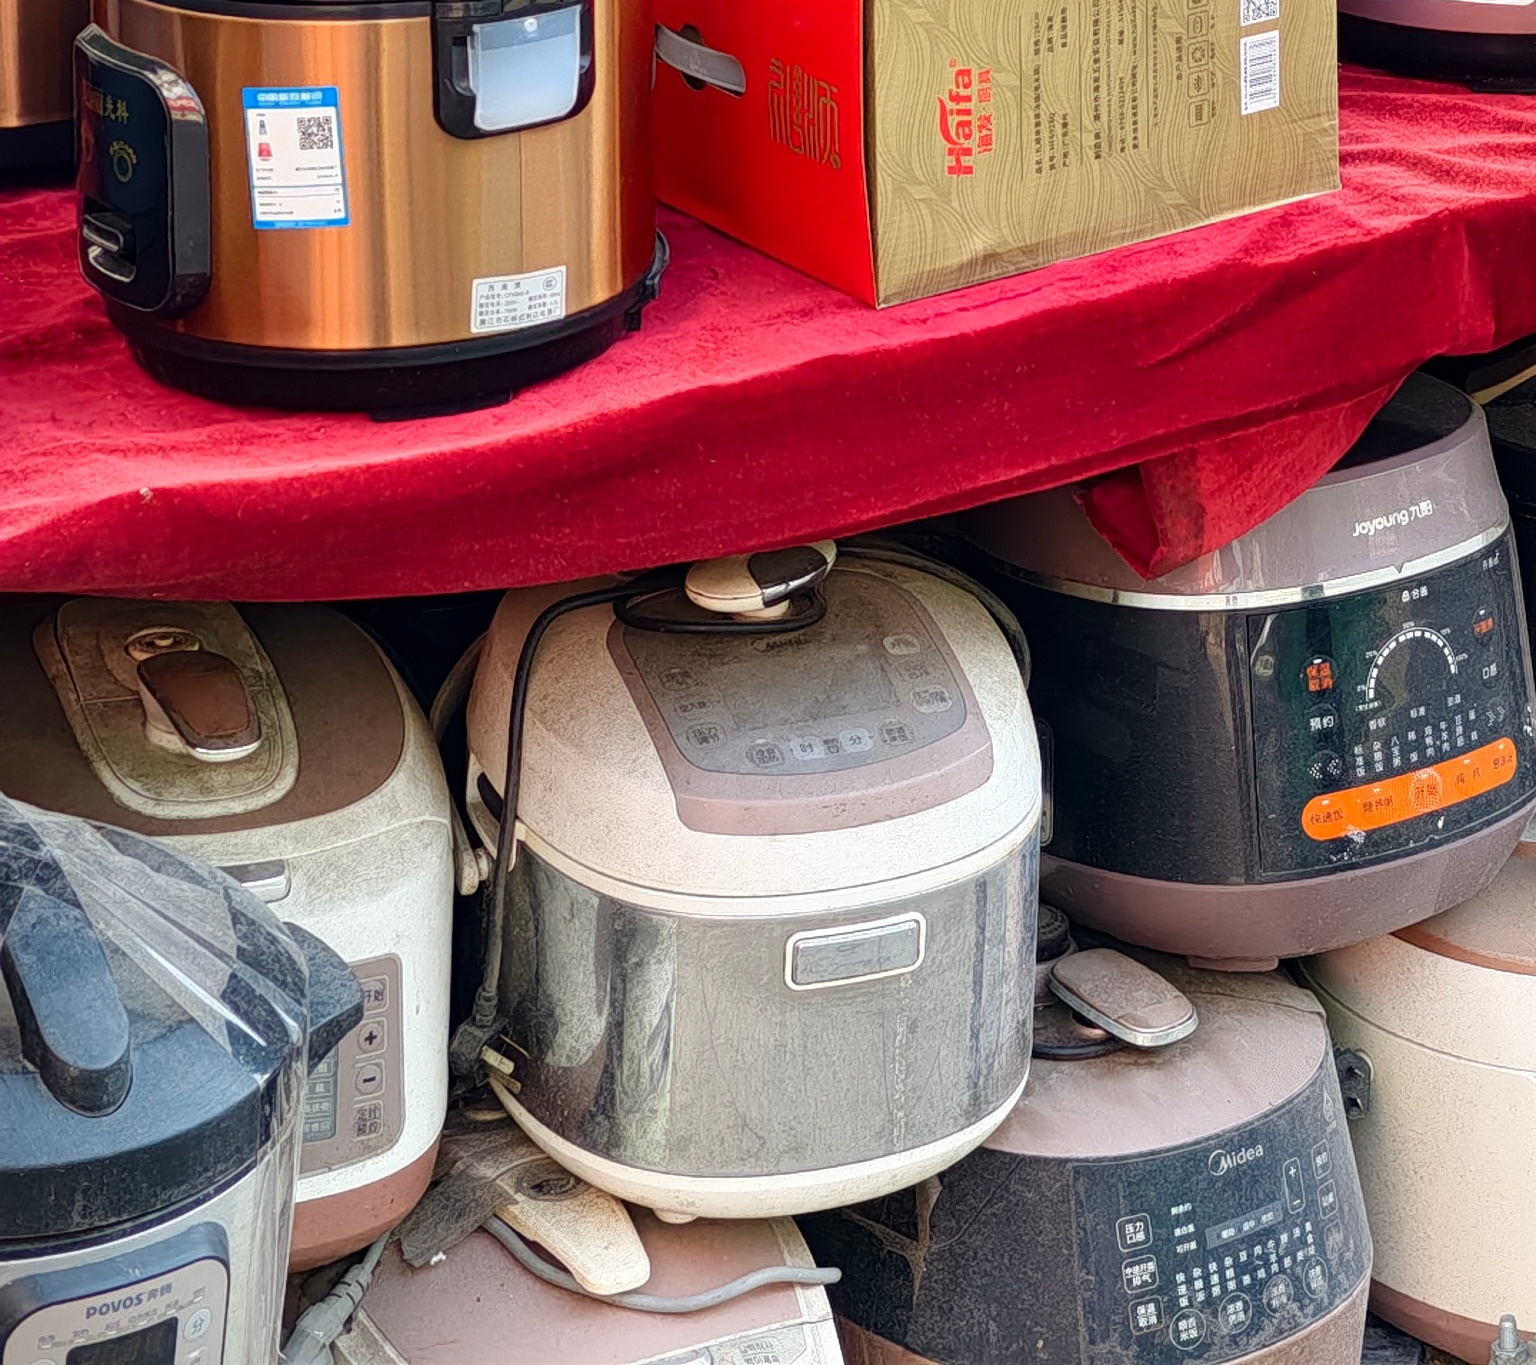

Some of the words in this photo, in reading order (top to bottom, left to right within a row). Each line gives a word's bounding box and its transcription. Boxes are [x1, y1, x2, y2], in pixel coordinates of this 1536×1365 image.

[938, 67, 975, 178] Haifa
[1352, 509, 1410, 537] Joyoung
[1409, 499, 1433, 523] 九阳
[1309, 714, 1334, 731] 预约
[1208, 1144, 1264, 1176] Midea
[1125, 1221, 1144, 1234] 压力
[1126, 1232, 1146, 1245] 口感
[85, 1291, 143, 1320] POVOS
